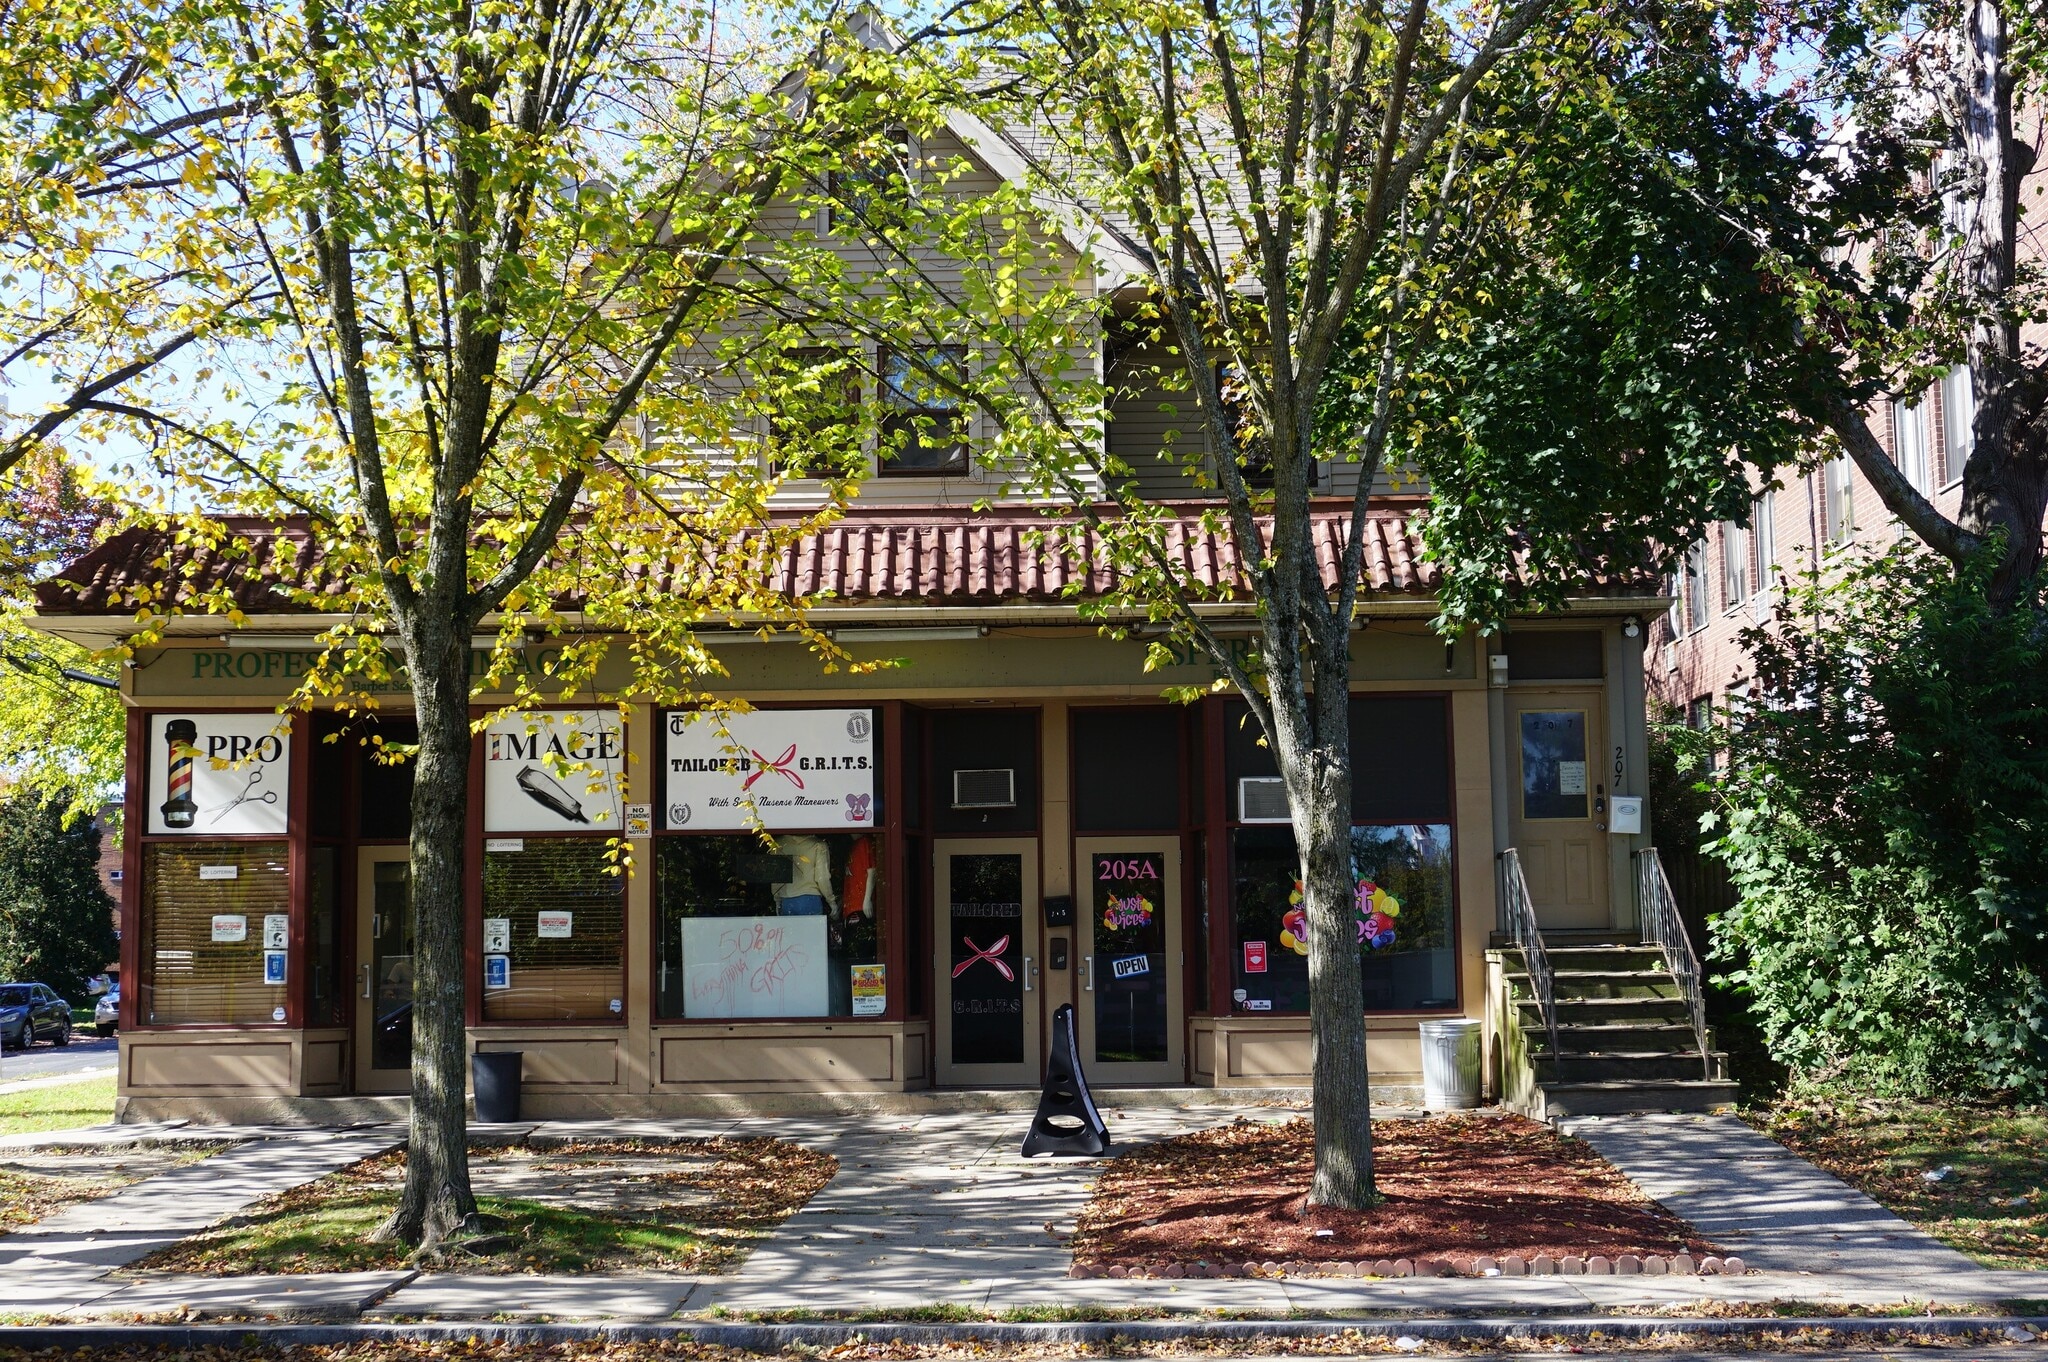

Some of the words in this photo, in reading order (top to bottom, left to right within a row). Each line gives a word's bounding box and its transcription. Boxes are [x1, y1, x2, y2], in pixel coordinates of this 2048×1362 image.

[469, 650, 581, 677] IMAG
[352, 680, 389, 692] Barber
[205, 735, 283, 763] PRO
[489, 732, 619, 761] IMAGE
[800, 756, 873, 771] G.R.I.T.S.
[708, 797, 730, 807] With
[733, 797, 755, 807] Se
[758, 796, 792, 807] Nusense
[794, 796, 839, 807] Maneuvers
[1099, 860, 1158, 880] 205A
[951, 903, 1021, 917] TAILORED
[1115, 957, 1147, 976] OPEN
